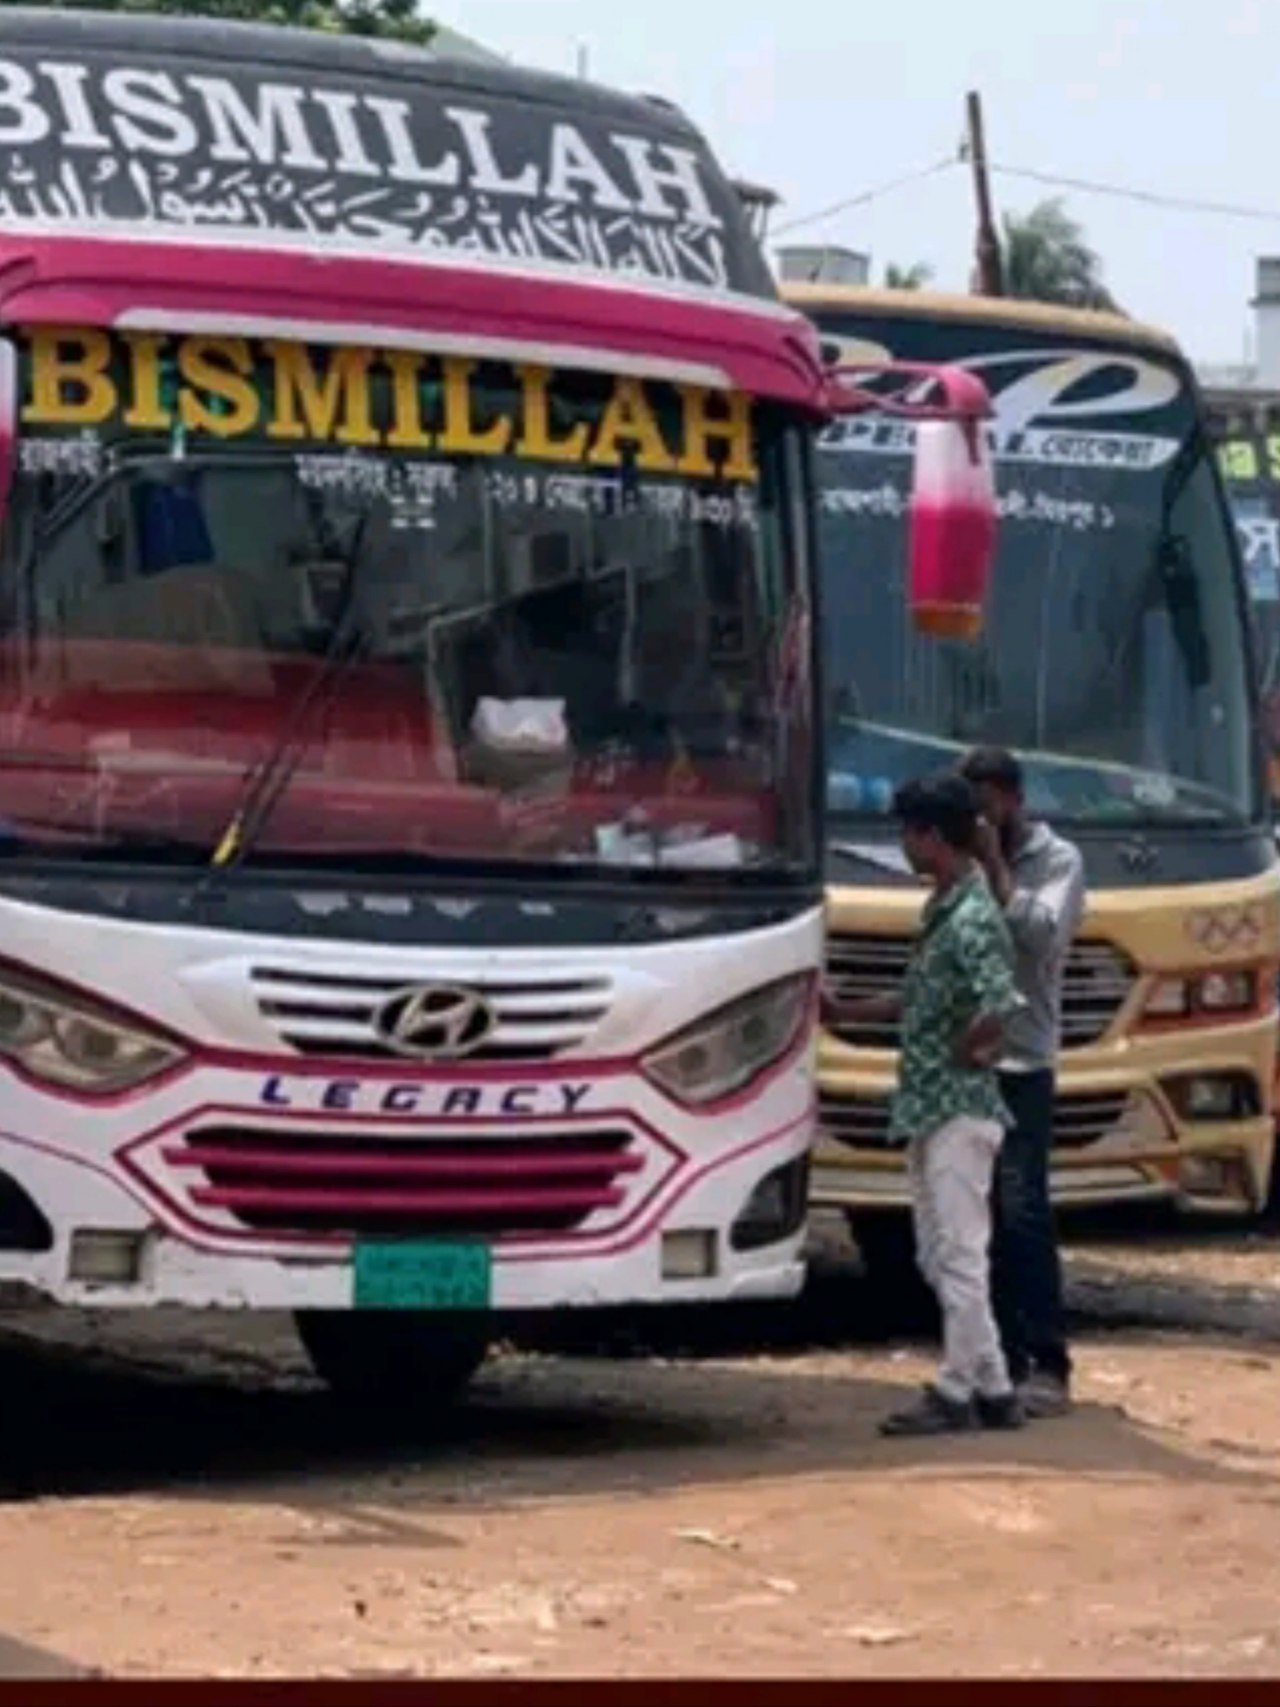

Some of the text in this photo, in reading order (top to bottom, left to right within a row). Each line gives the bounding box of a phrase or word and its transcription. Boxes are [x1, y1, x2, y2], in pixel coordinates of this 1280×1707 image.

[0, 58, 724, 230] BISMILLAH
[20, 325, 758, 483] BISMILLAH
[1218, 438, 1257, 480] a
[260, 1075, 592, 1114] LEGACY
